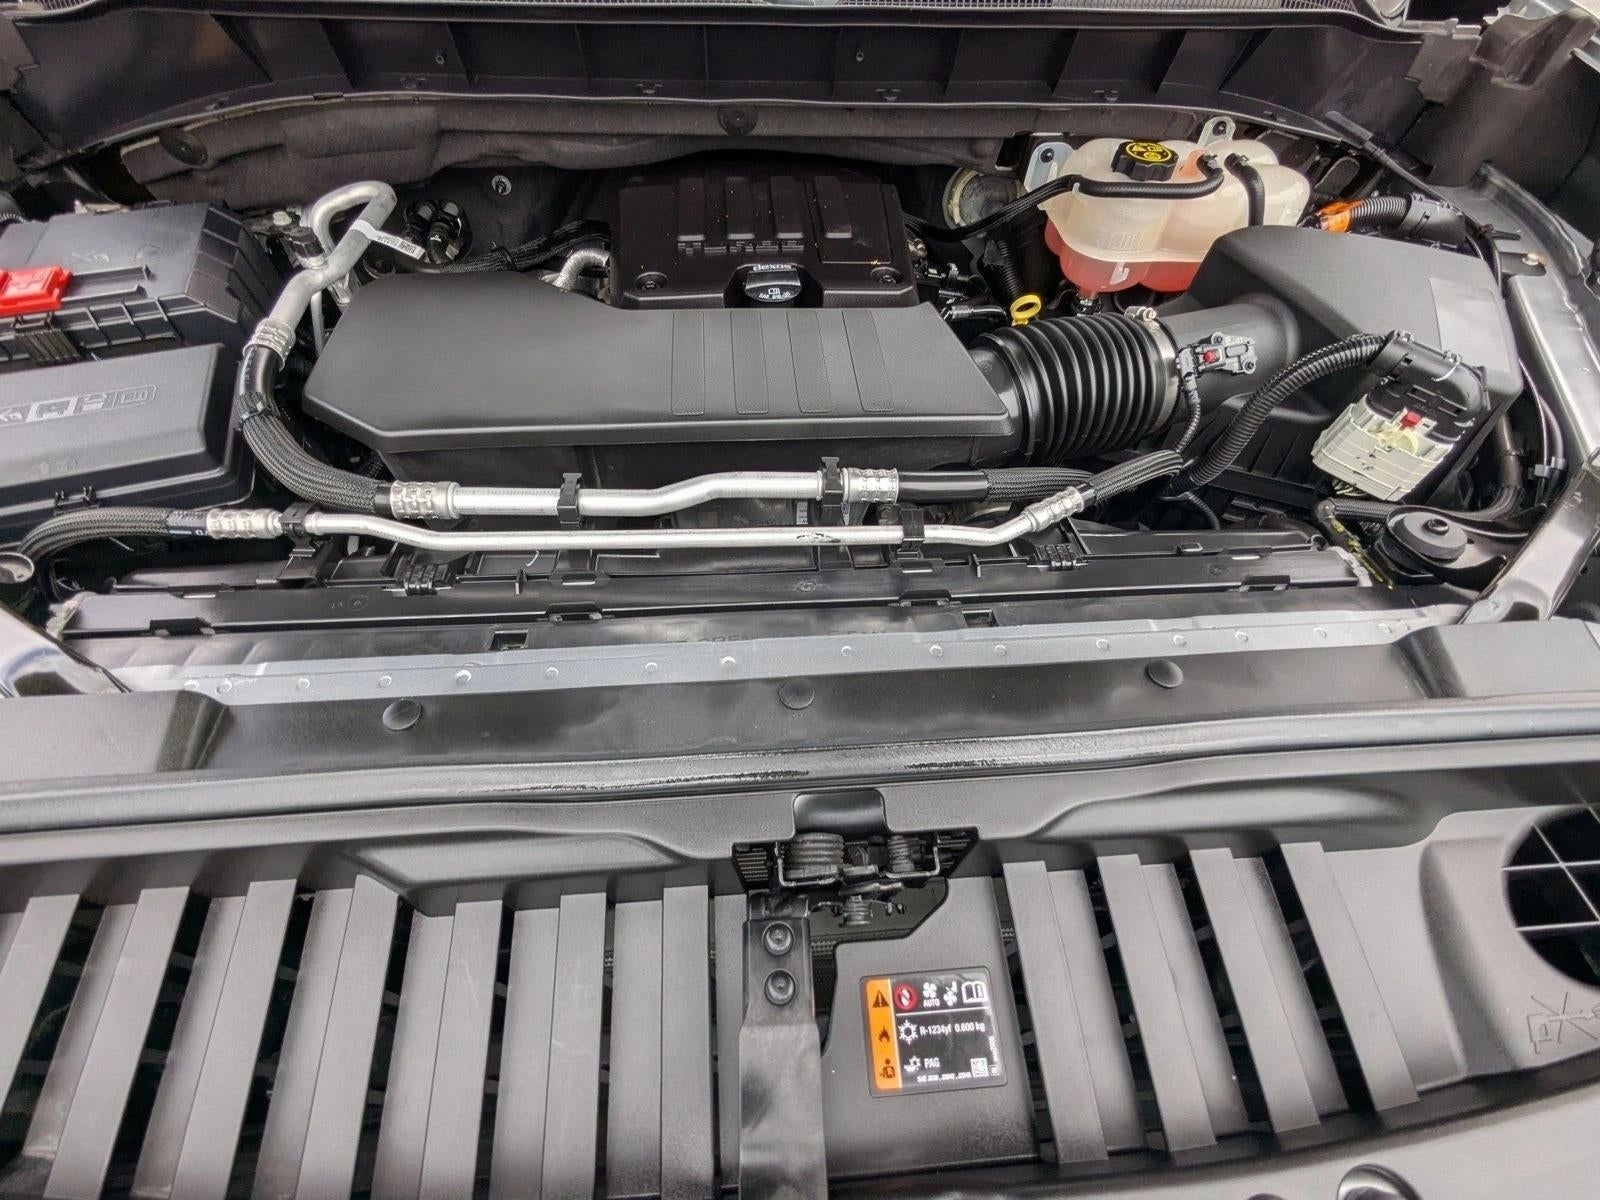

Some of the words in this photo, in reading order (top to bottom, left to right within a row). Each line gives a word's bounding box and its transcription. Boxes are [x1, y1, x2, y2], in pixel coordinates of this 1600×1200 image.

[752, 263, 792, 271] dexos
[922, 998, 940, 1008] AUTO
[919, 1023, 952, 1036] R-1234yf
[976, 1021, 986, 1033] kg
[924, 1057, 940, 1069] PAG
